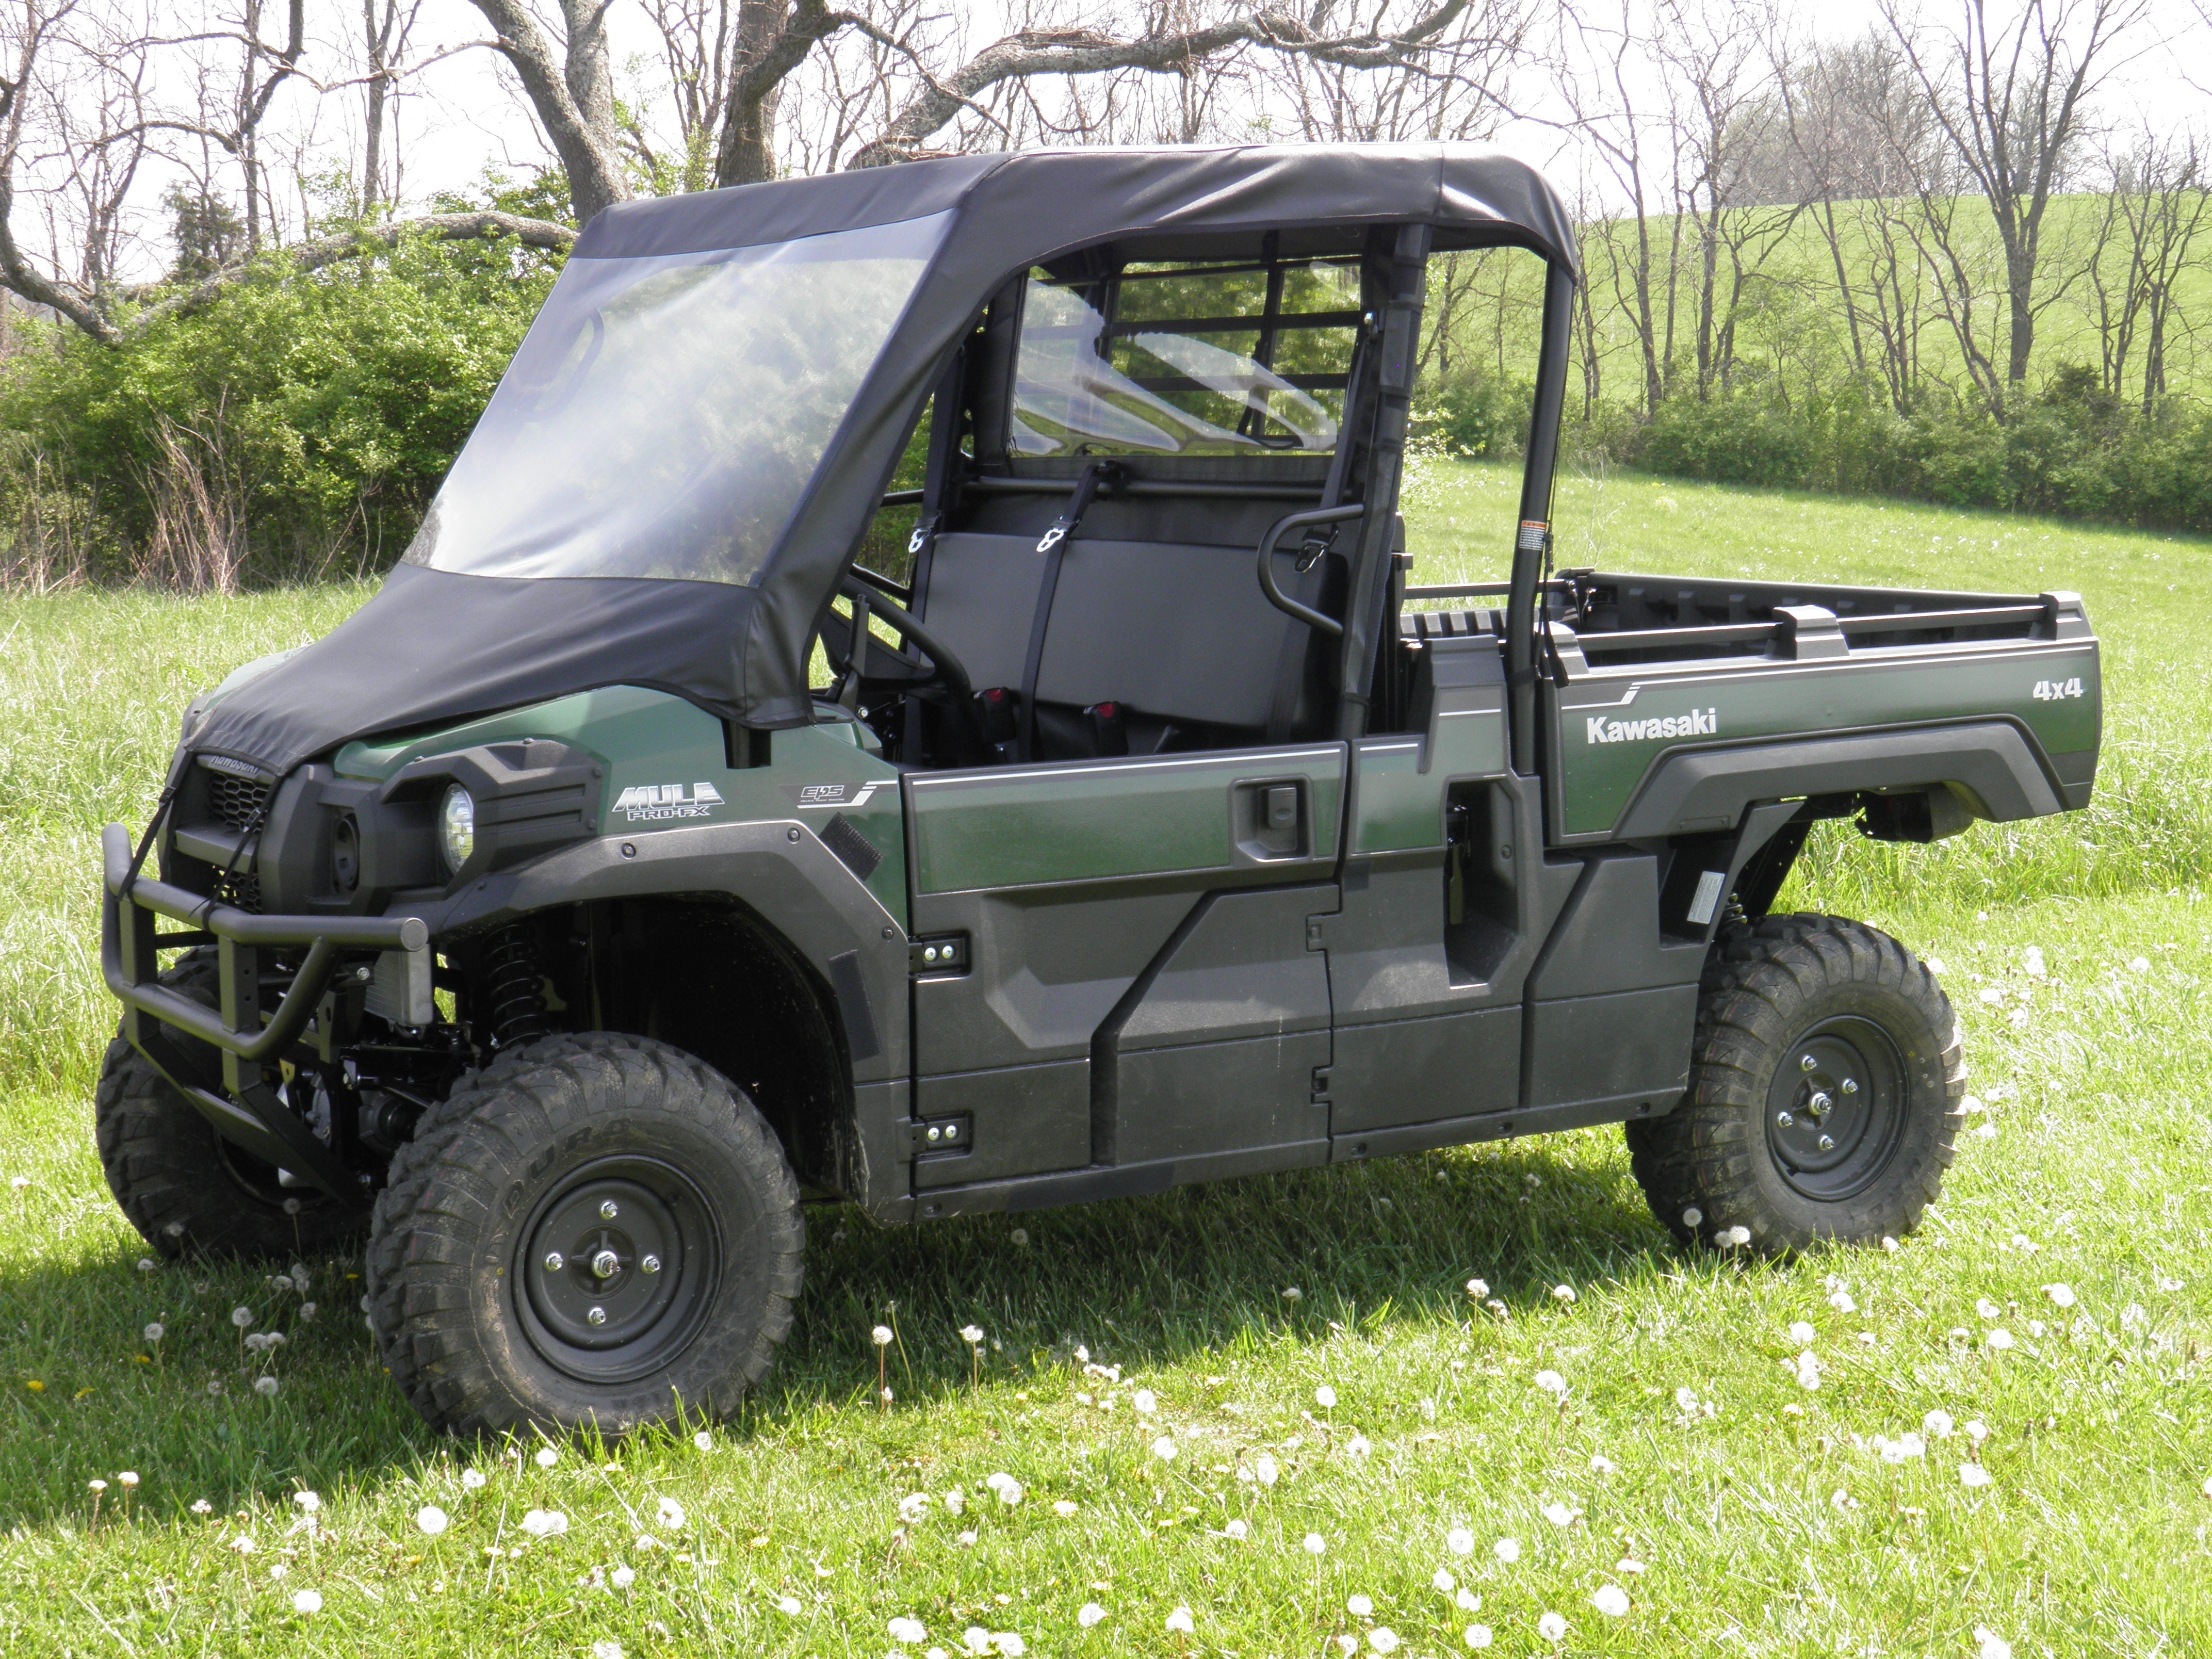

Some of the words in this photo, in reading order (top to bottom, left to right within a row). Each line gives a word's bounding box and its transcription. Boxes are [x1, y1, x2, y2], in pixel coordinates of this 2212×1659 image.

[2032, 677, 2084, 701] 4x4
[1586, 707, 1717, 744] Kawasaki
[612, 782, 725, 812] MULE
[626, 806, 711, 821] PRO-FX
